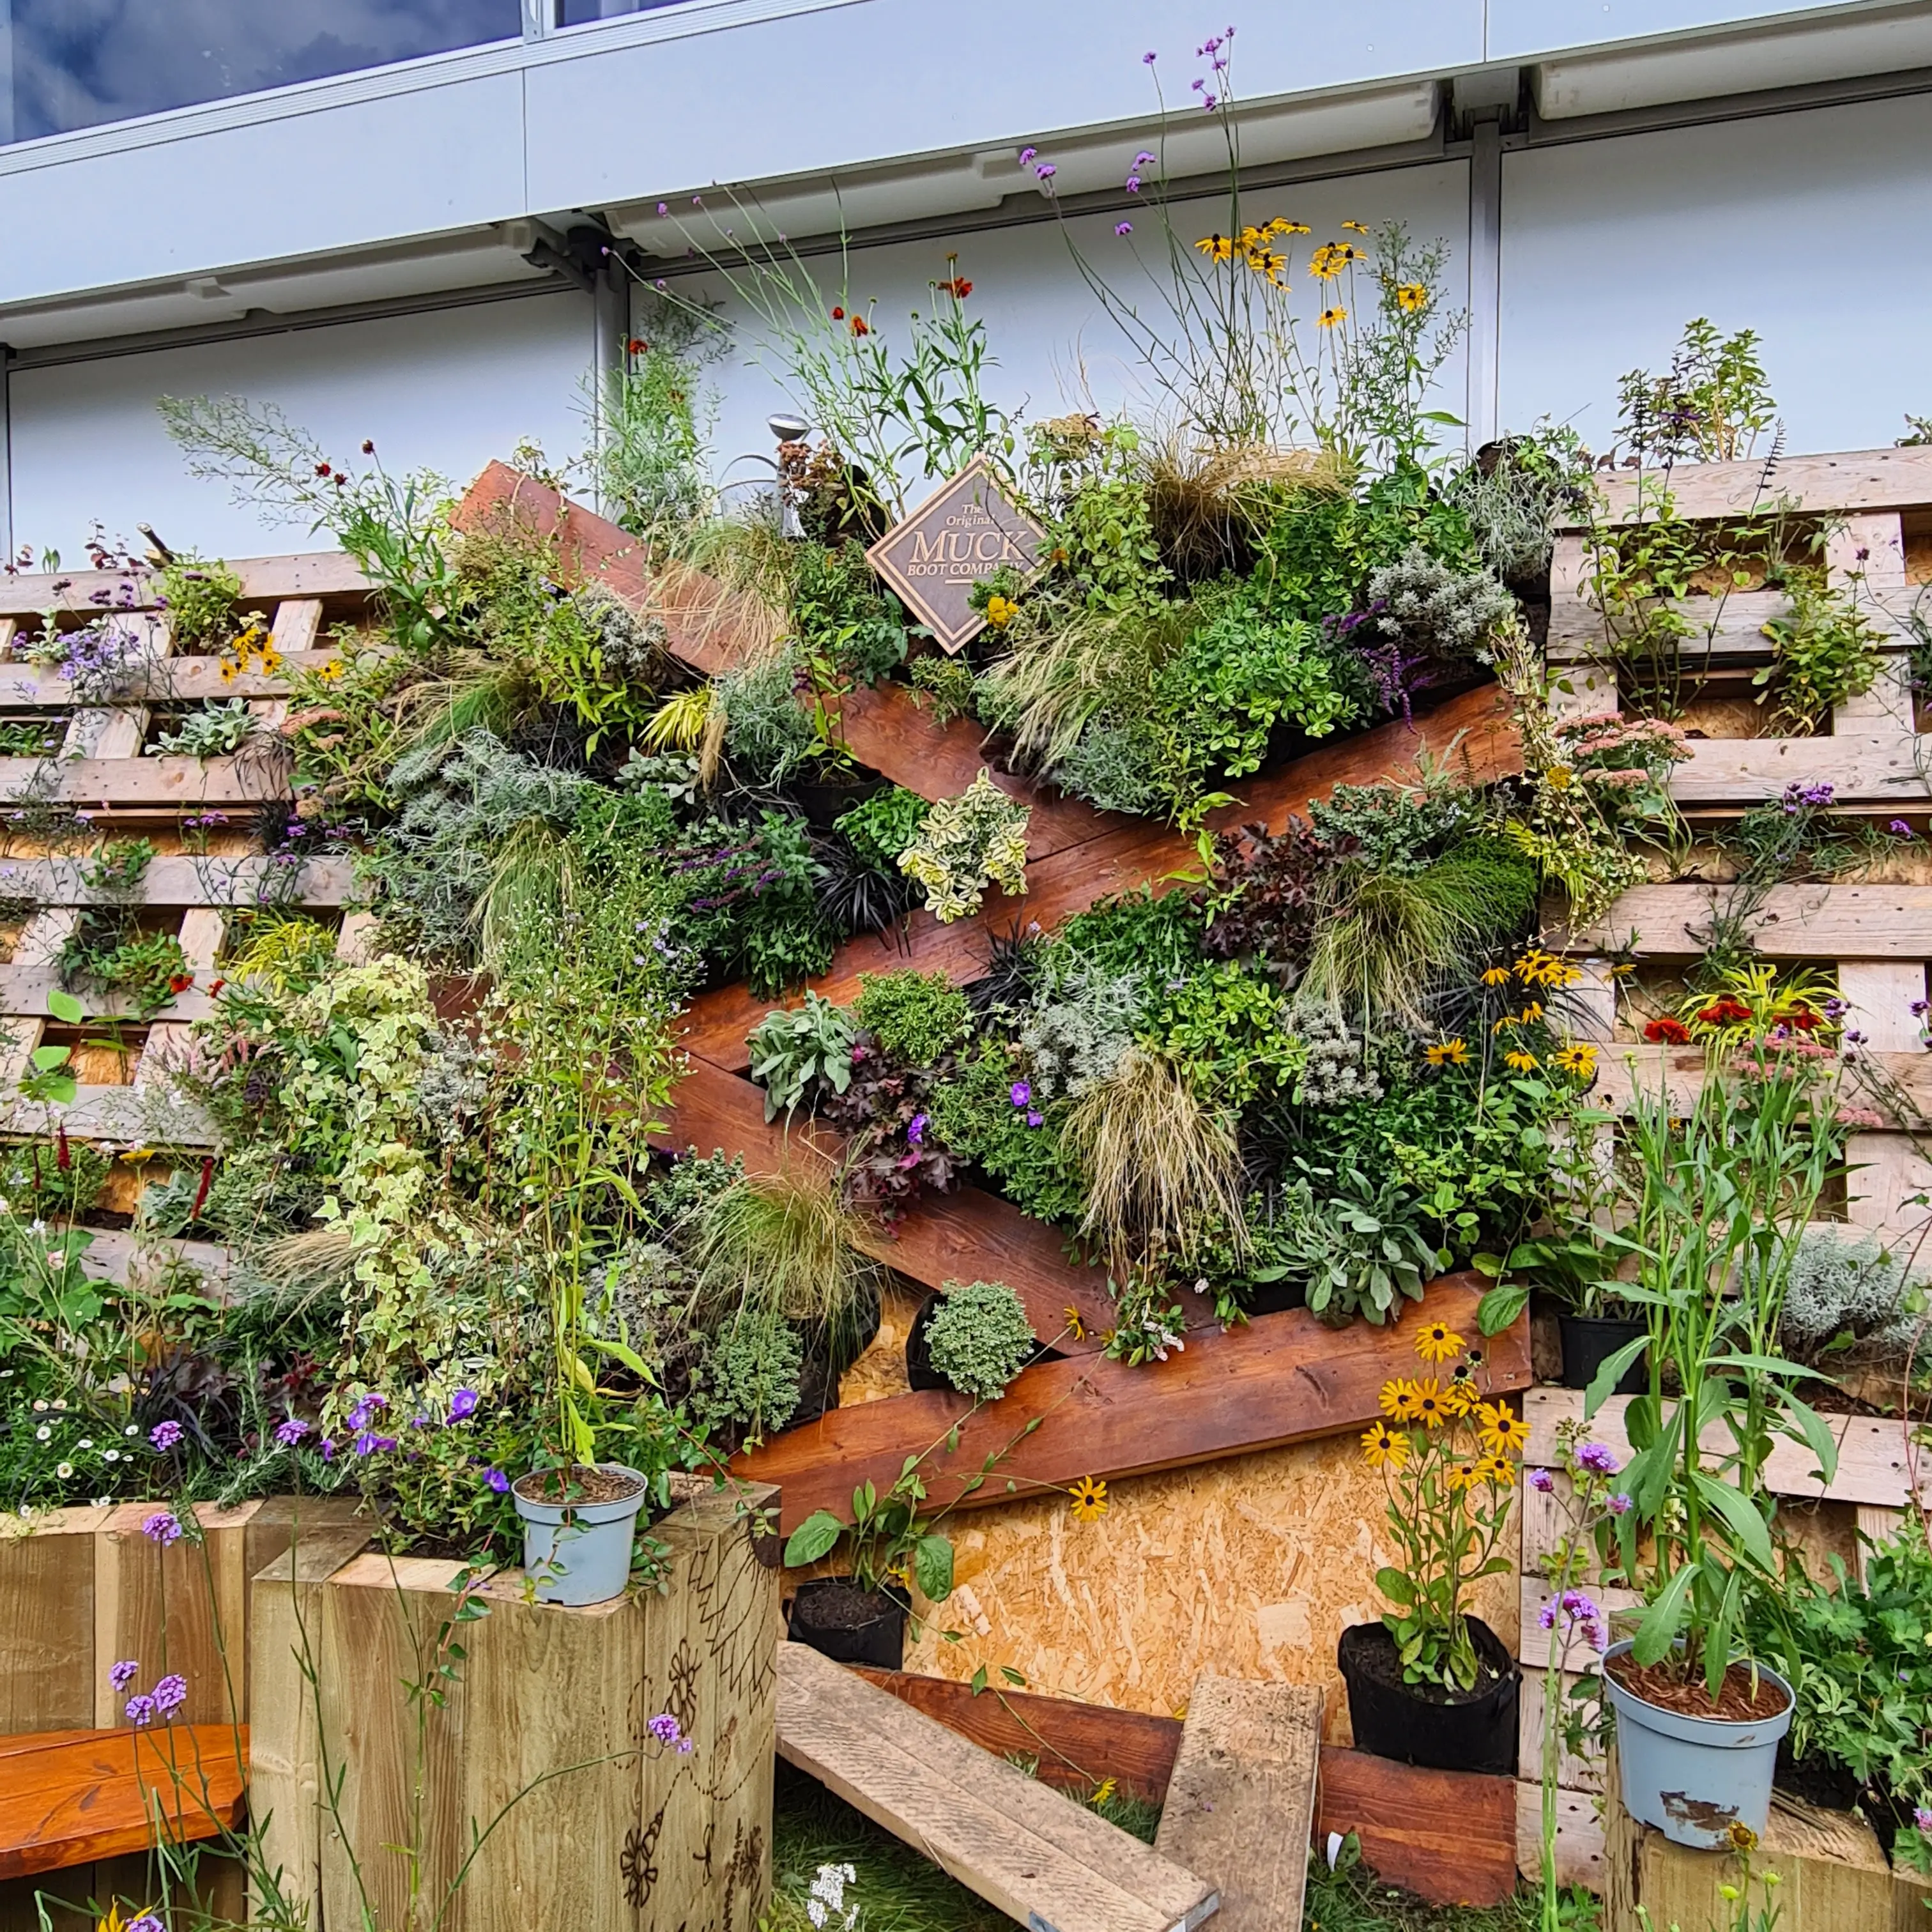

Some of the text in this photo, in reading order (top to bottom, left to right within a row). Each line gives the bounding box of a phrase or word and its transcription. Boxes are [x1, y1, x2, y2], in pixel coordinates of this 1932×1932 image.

[962, 504, 984, 514] The
[946, 515, 995, 528] Original
[909, 530, 1028, 563] MUCK
[907, 564, 947, 576] BOOT
